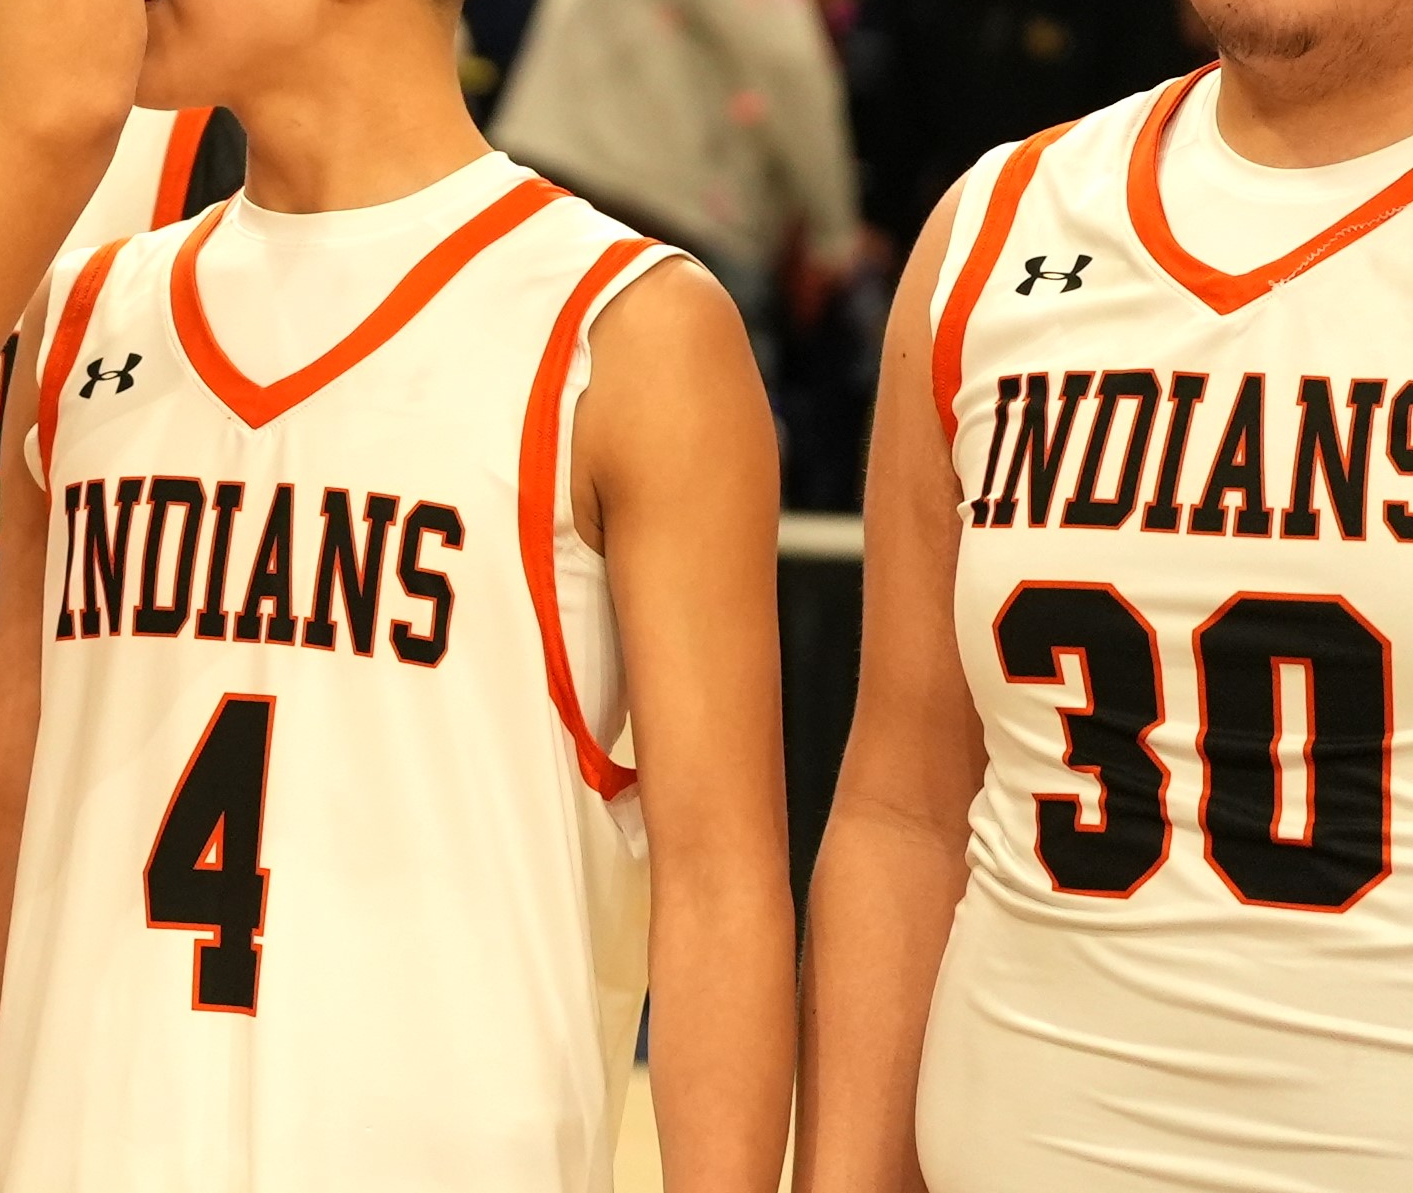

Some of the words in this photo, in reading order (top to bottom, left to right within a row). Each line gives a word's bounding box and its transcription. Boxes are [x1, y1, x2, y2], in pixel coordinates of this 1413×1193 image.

[55, 475, 466, 669] INDIANS
[143, 692, 277, 1018] 4
[992, 579, 1393, 914] 30
